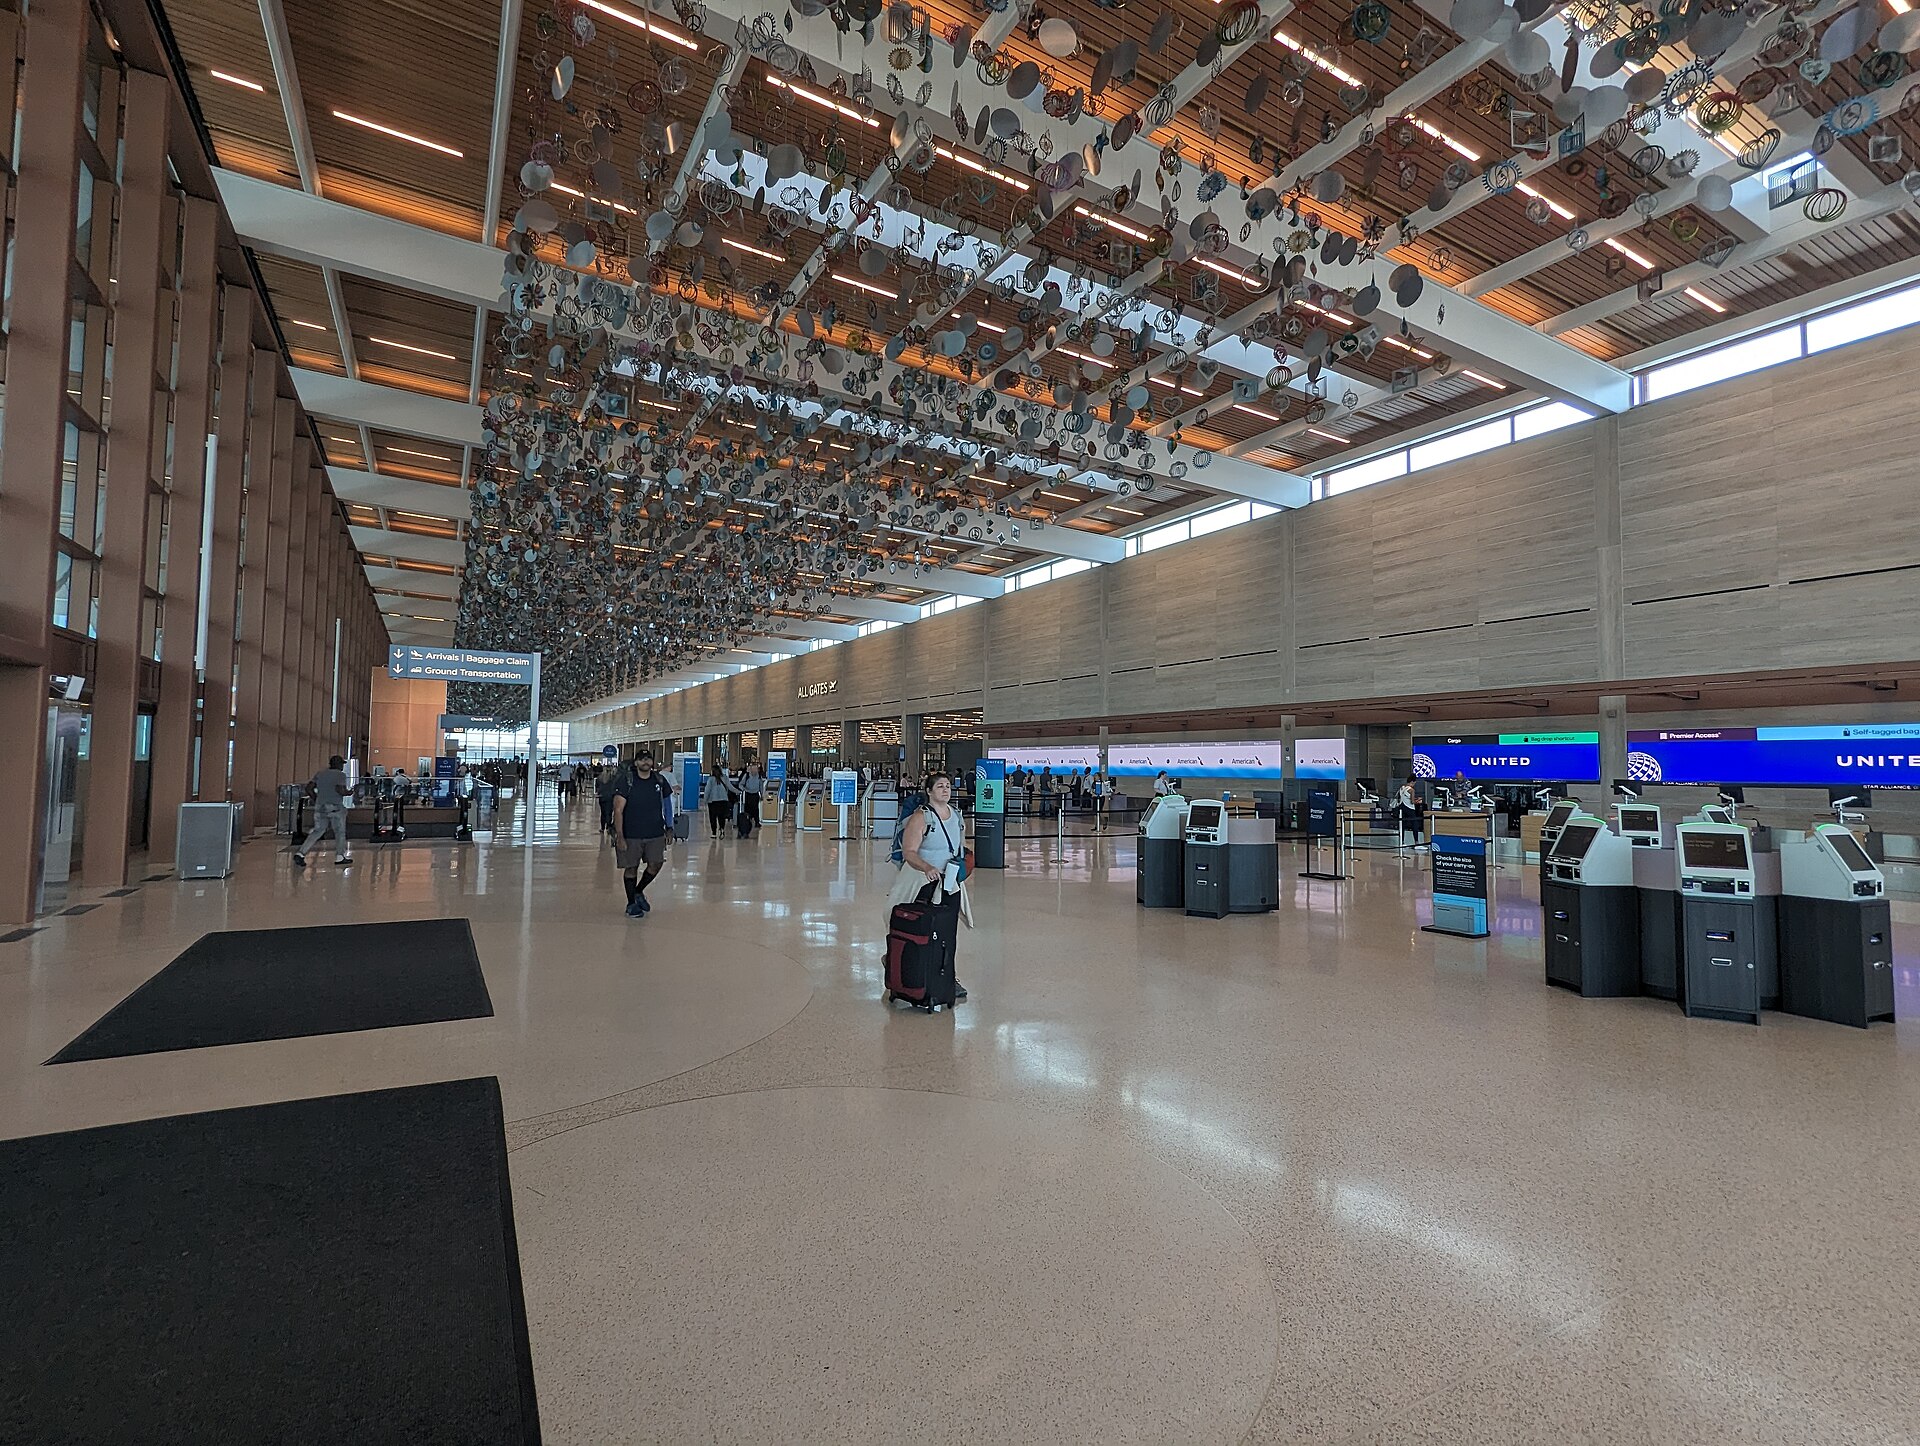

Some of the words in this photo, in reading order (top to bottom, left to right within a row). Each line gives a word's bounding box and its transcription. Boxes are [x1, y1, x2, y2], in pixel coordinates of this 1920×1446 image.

[425, 652, 460, 662] Arrivals
[466, 655, 505, 665] Baggage
[506, 657, 530, 666] Claim
[424, 667, 458, 676] Ground
[460, 669, 522, 680] Transportation
[797, 686, 809, 699] ALL
[809, 681, 828, 697] GATES
[1852, 728, 1902, 736] Self-tagged
[1903, 728, 1920, 736] bag
[1470, 757, 1531, 766] UNITED
[1435, 854, 1452, 862] Check
